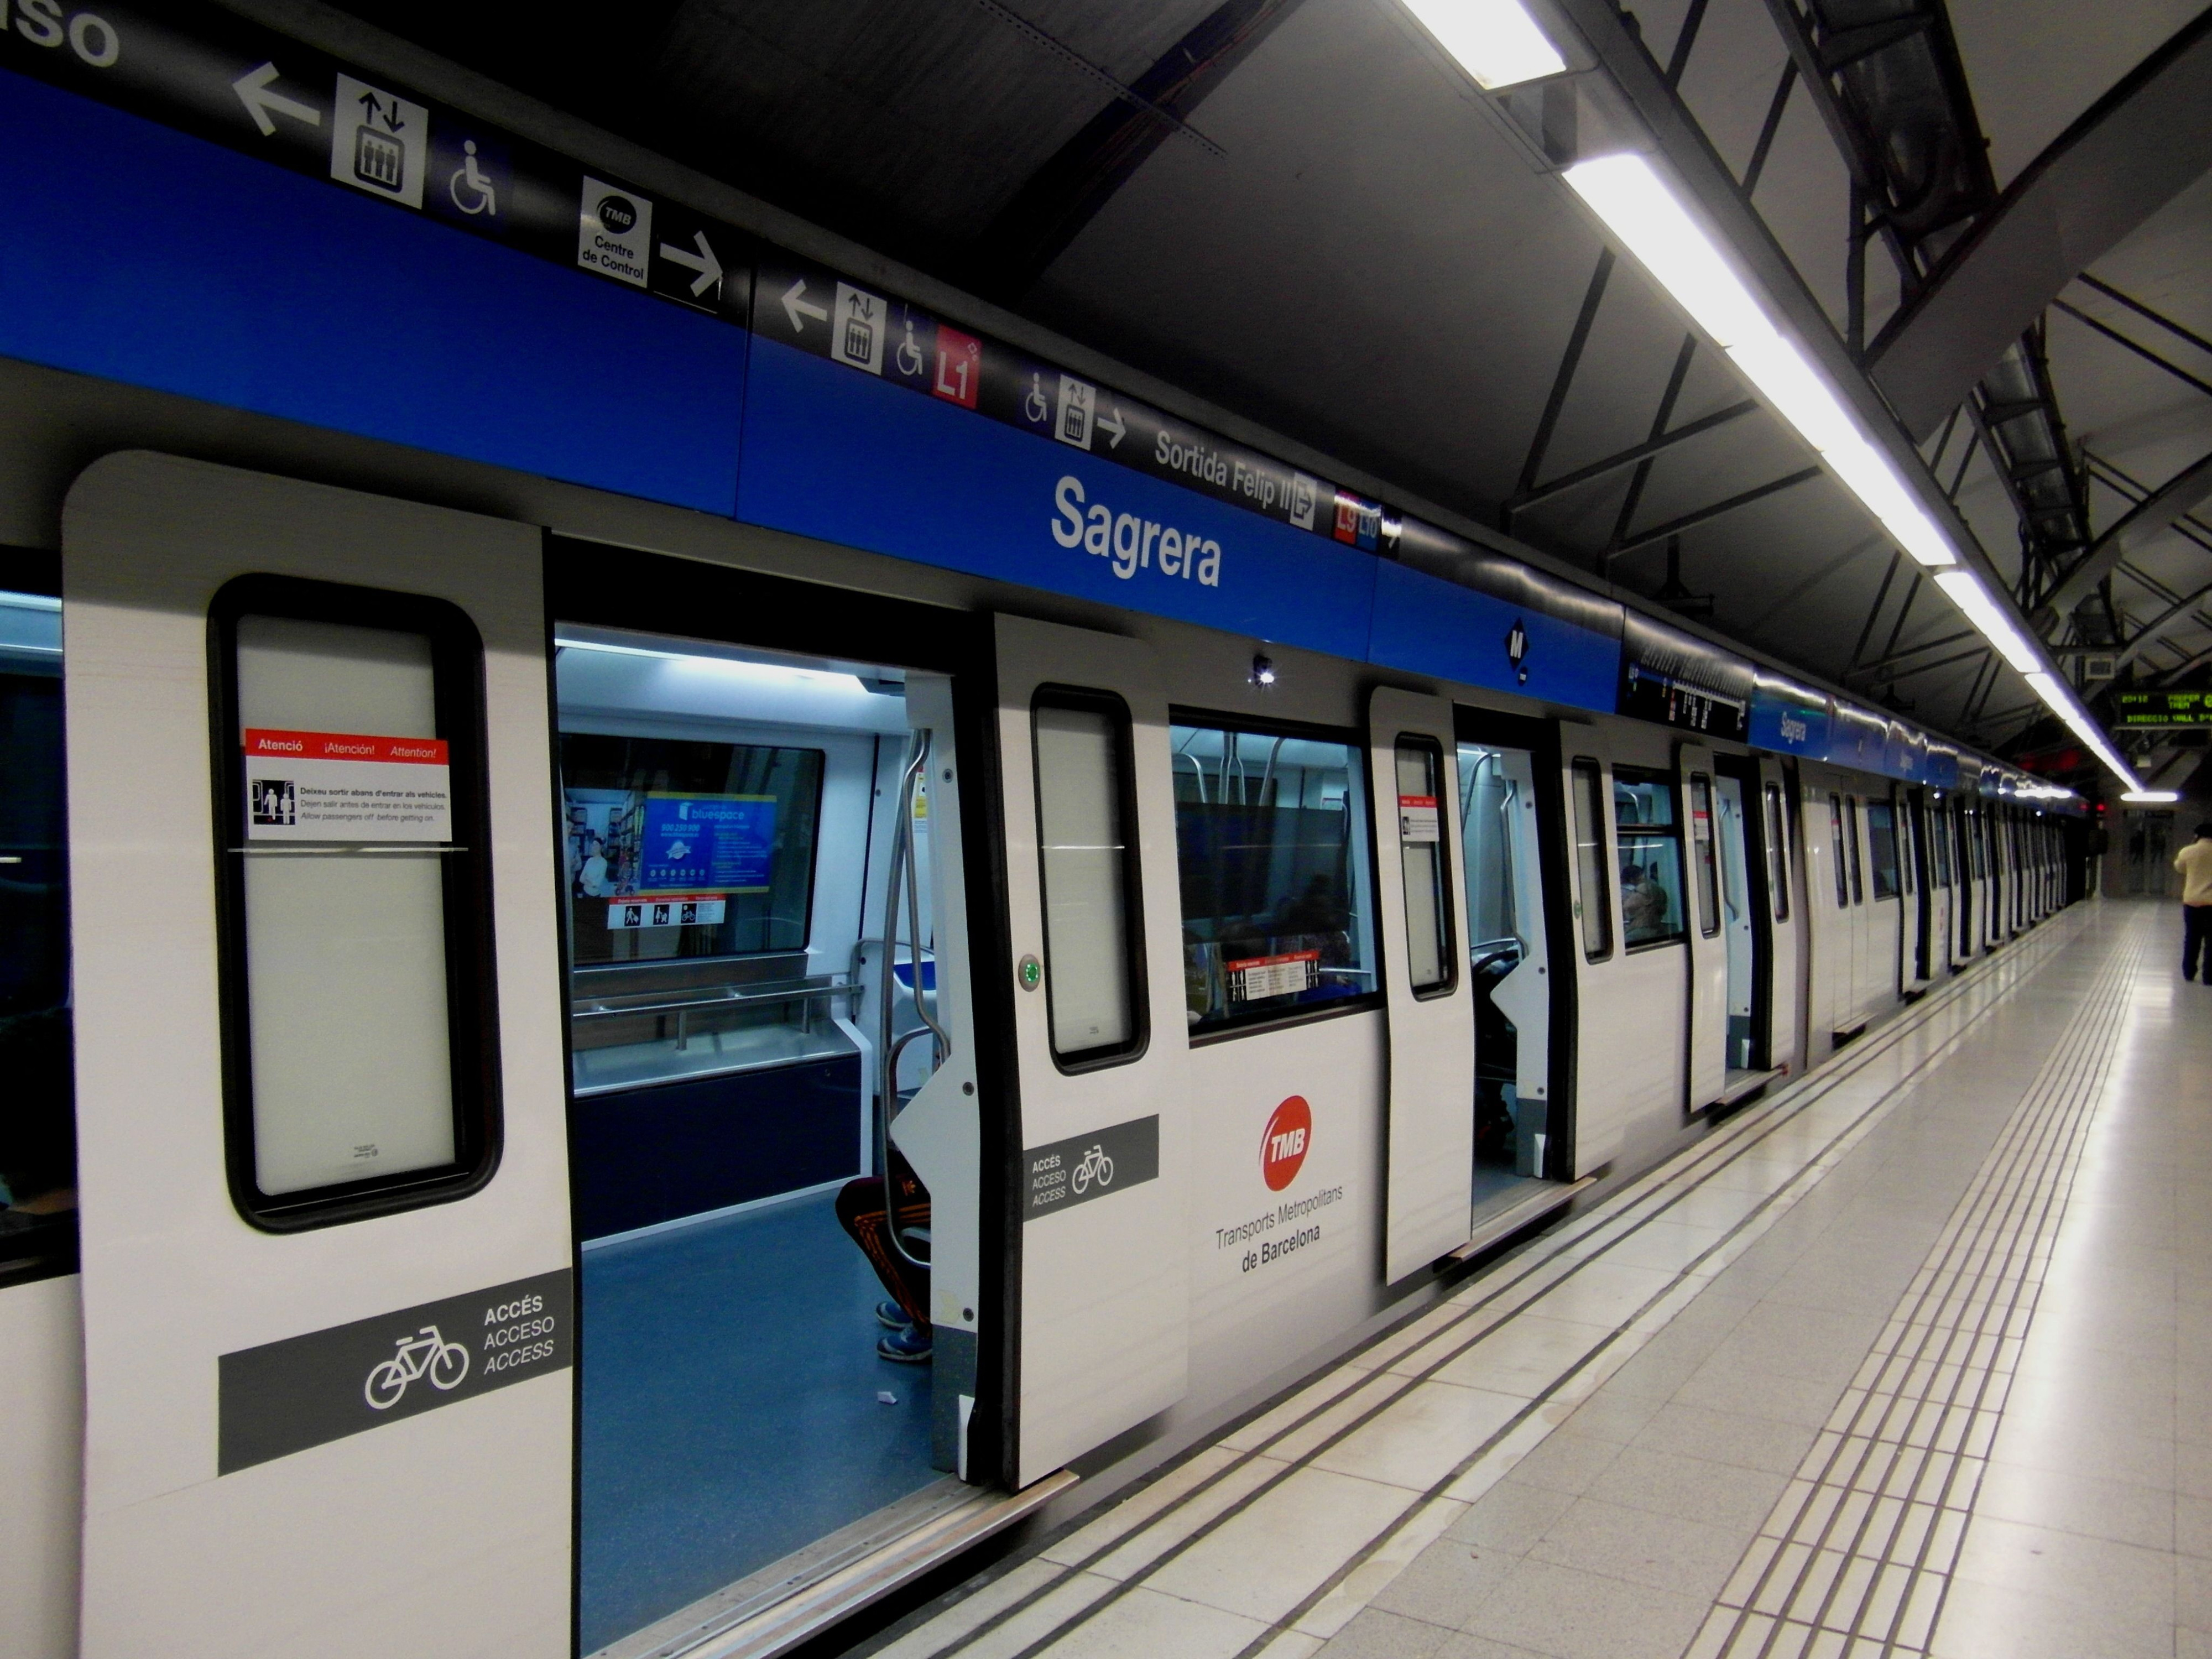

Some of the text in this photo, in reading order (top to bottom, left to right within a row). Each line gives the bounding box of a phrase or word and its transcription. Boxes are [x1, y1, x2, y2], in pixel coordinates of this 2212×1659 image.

[0, 0, 118, 67] so
[605, 206, 632, 226] TMB
[594, 235, 634, 259] Centre
[582, 249, 644, 280] de Control
[937, 351, 968, 400] L1
[1155, 430, 1291, 512] Sortida Felip II
[1052, 475, 1221, 587] Sagrera
[1336, 504, 1379, 539] L9 L10
[1780, 711, 1807, 745] Sagrera
[258, 738, 437, 758] Atenció ¡Atención! Attention!
[300, 800, 321, 808] Dejen
[321, 813, 363, 823] passengers
[377, 813, 399, 821] before
[399, 815, 424, 823] getting
[691, 809, 745, 822] bluespace
[1271, 1128, 1306, 1162] TMB
[1032, 1170, 1067, 1191] ACCESO
[1032, 1186, 1066, 1207] ACCESS
[1216, 1186, 1343, 1249] Transports Metropolitans
[1242, 1225, 1320, 1272] de Barcelona
[484, 1295, 543, 1326] ACCÉS
[484, 1316, 555, 1350] ACCESO
[484, 1339, 554, 1375] ACCESS
